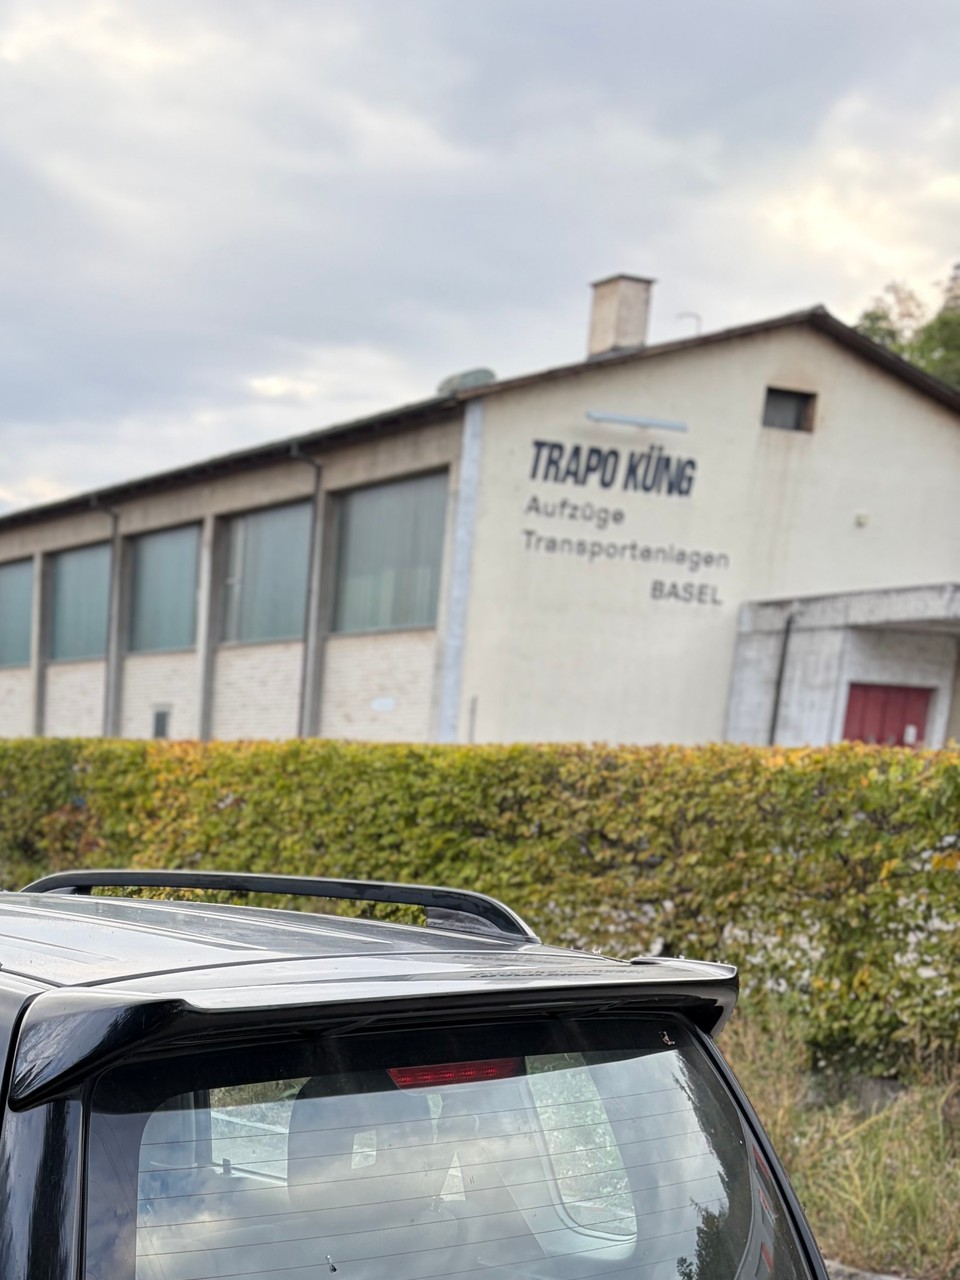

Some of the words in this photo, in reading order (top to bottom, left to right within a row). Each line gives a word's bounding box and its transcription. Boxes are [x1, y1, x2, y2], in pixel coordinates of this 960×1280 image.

[529, 439, 619, 489] TRAPO
[623, 443, 697, 496] KÜNG
[524, 496, 625, 530] Aufzüge
[522, 529, 730, 572] Transportanlagen
[651, 579, 723, 605] BASEL
